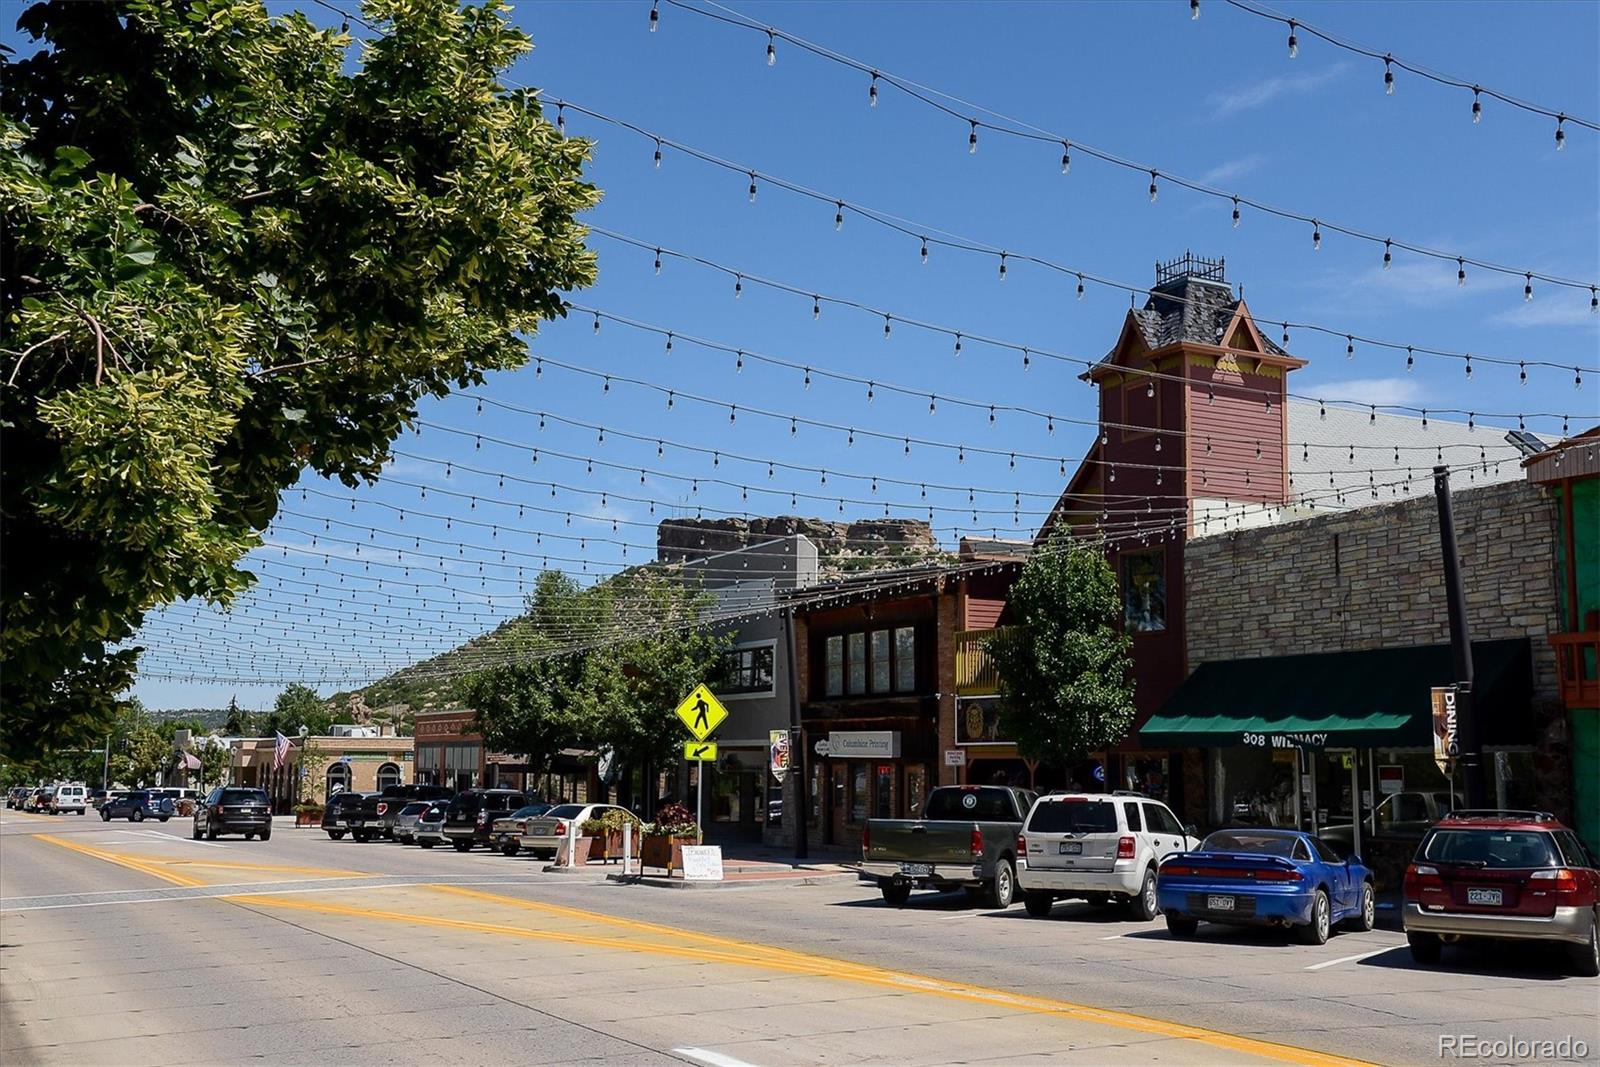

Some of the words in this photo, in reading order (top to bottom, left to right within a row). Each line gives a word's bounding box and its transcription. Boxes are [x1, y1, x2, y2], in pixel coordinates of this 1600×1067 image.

[1243, 732, 1266, 747] 308
[1445, 692, 1459, 757] DINING
[780, 733, 789, 768] EVENTS
